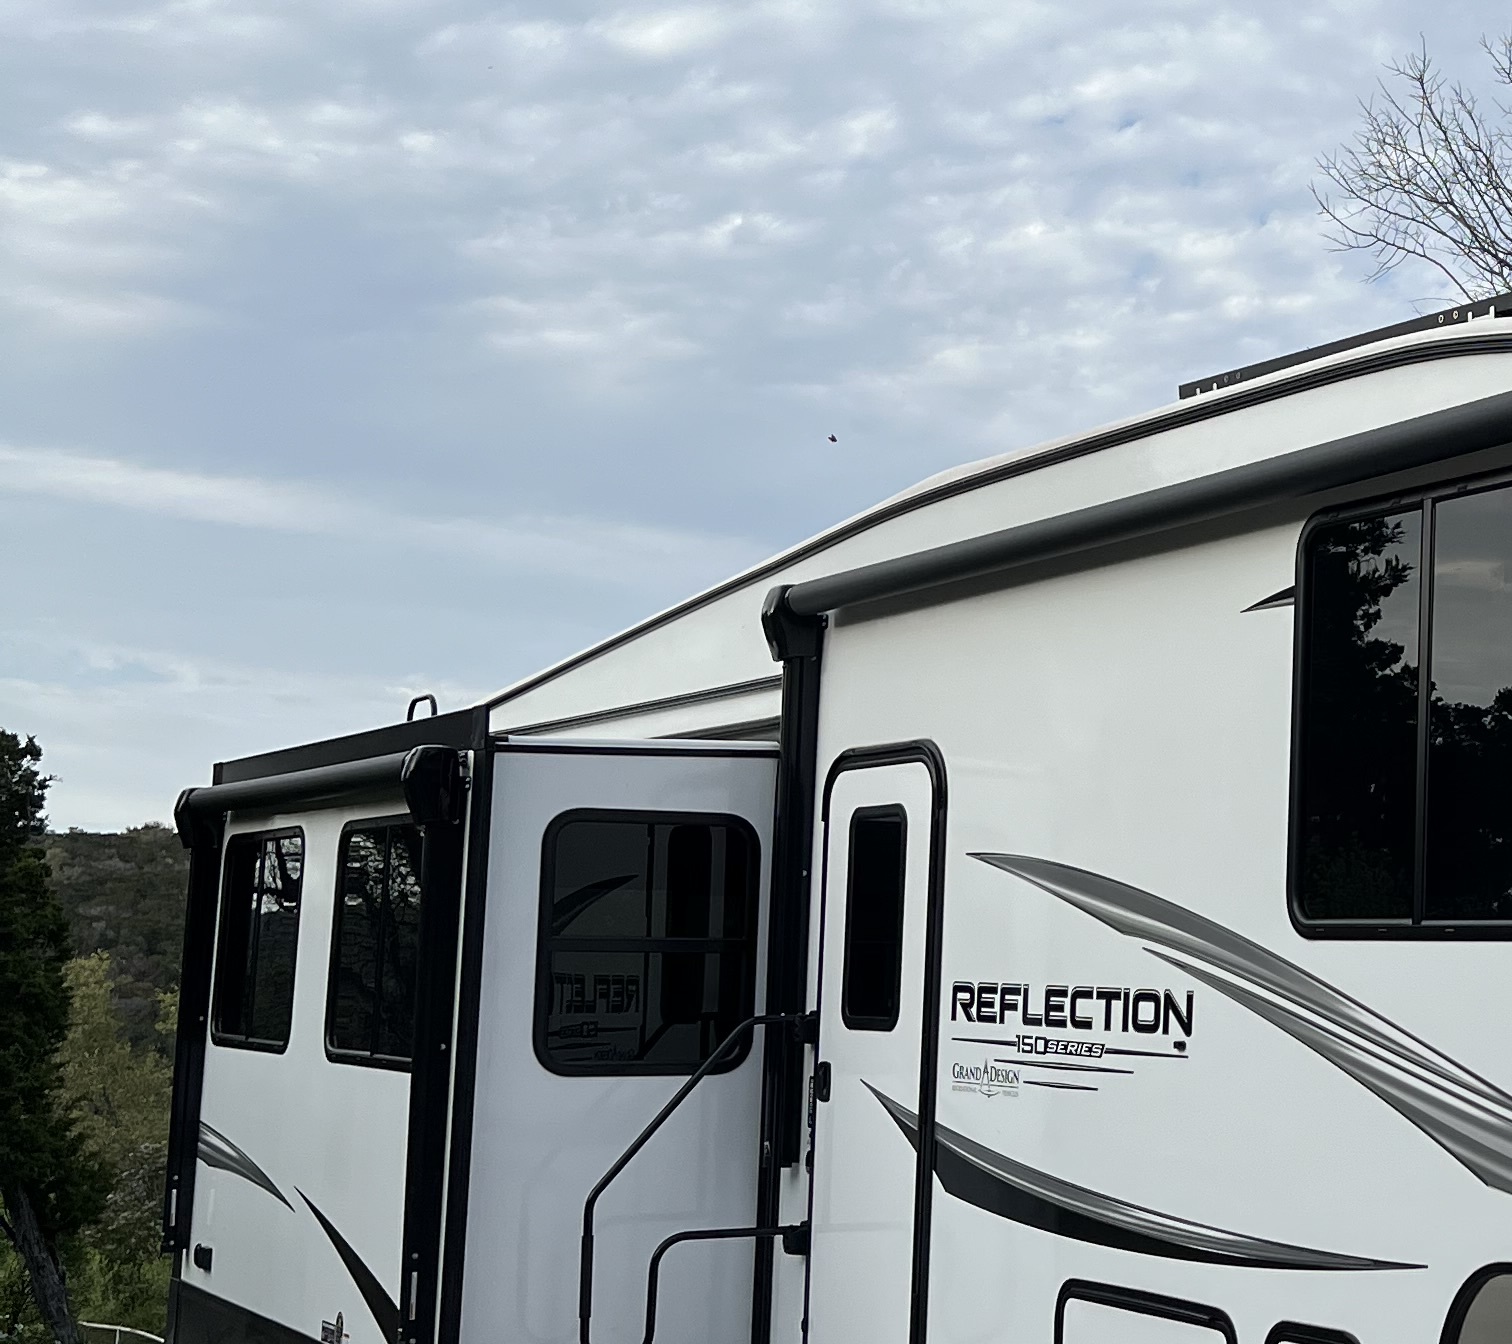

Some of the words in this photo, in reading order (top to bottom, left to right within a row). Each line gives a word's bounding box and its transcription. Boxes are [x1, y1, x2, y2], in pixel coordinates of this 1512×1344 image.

[950, 980, 1195, 1038] REFLECTION
[1016, 1034, 1048, 1055] 150
[1046, 1040, 1103, 1057] SERIES
